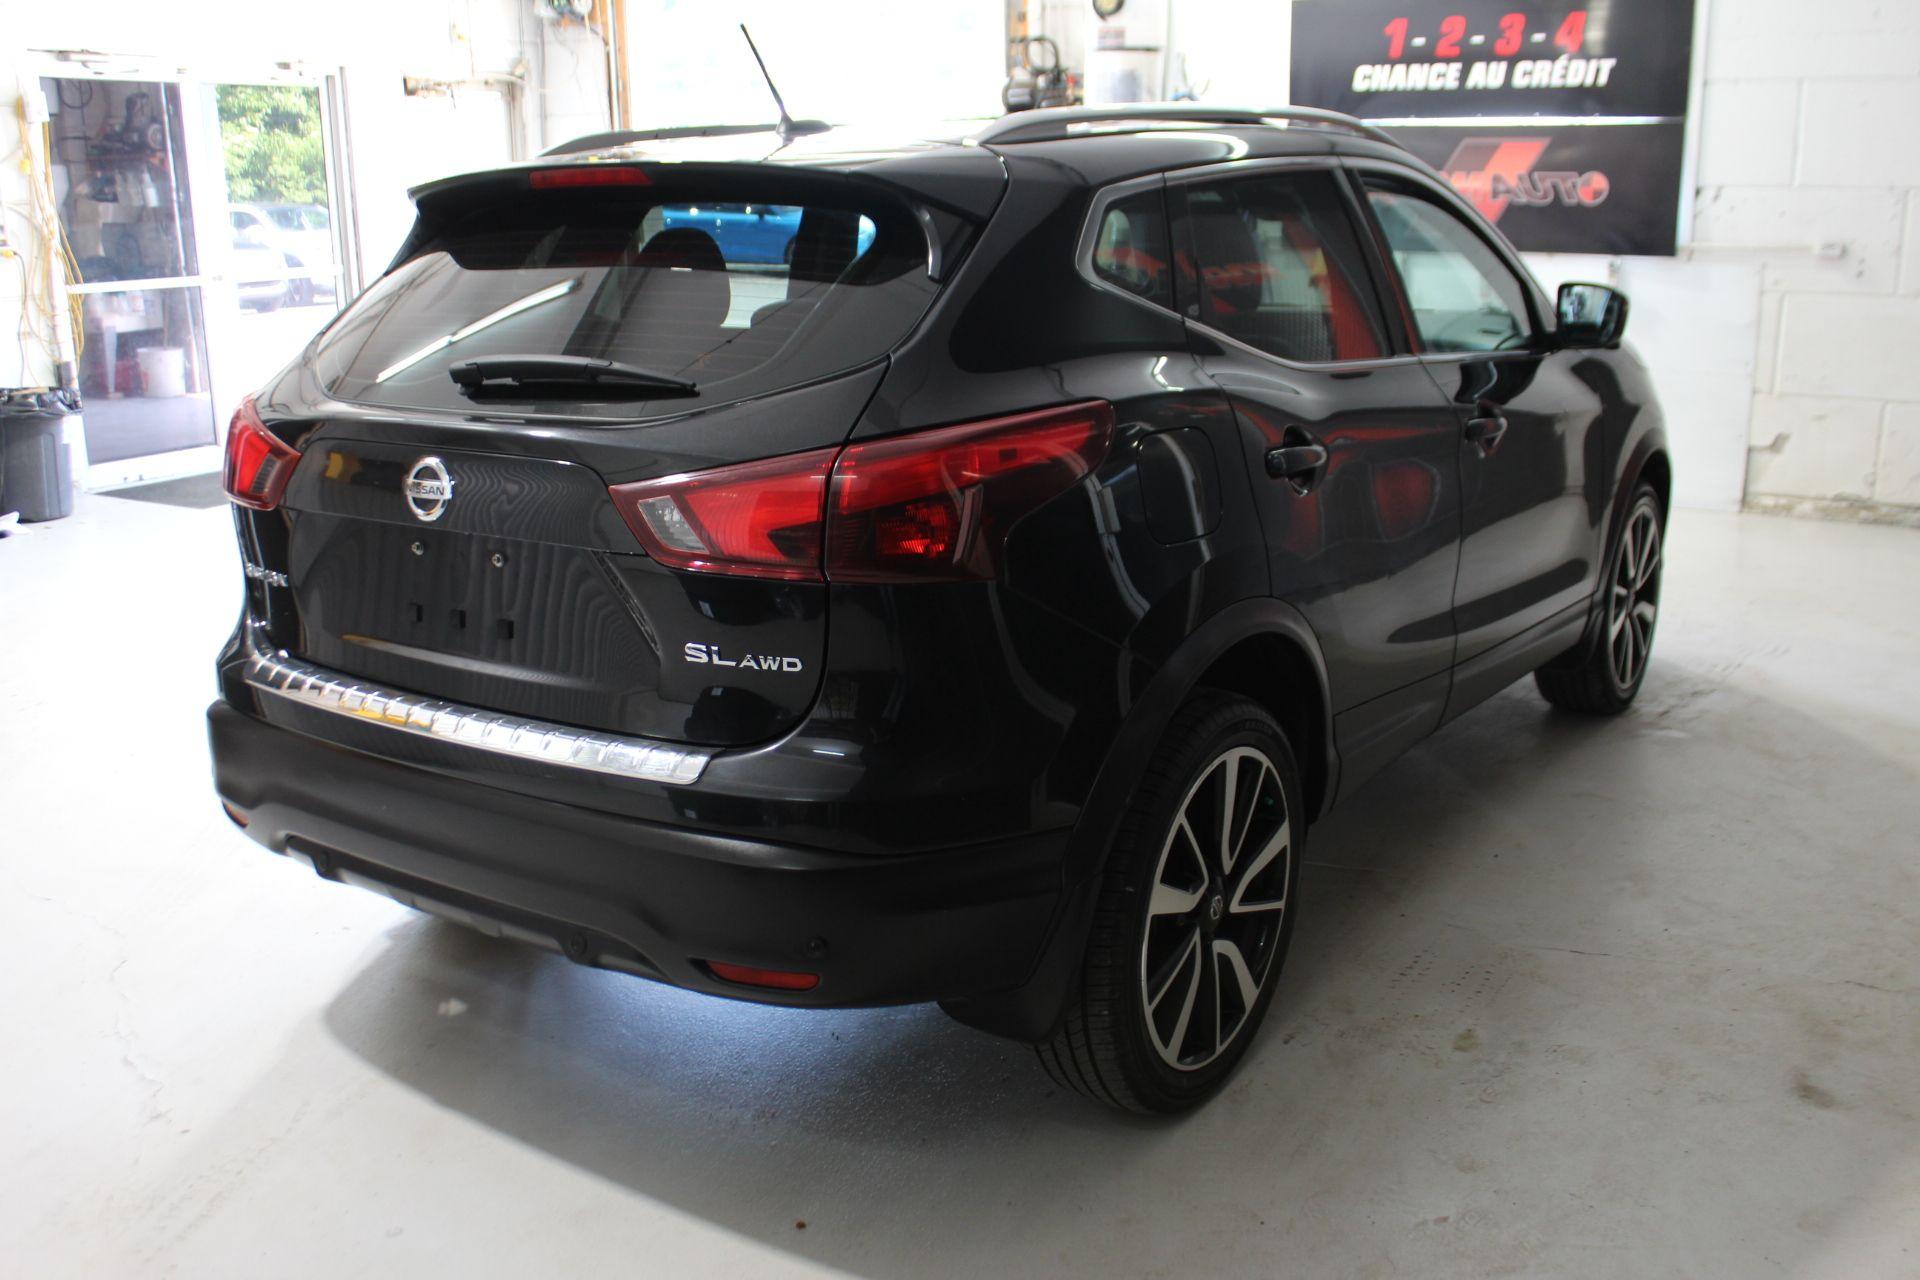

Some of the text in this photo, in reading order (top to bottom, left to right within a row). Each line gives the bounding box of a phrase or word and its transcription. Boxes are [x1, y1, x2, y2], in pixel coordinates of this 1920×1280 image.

[1351, 53, 1617, 92] CHANCE AU CRÉDIT
[684, 642, 803, 672] SL AWD
